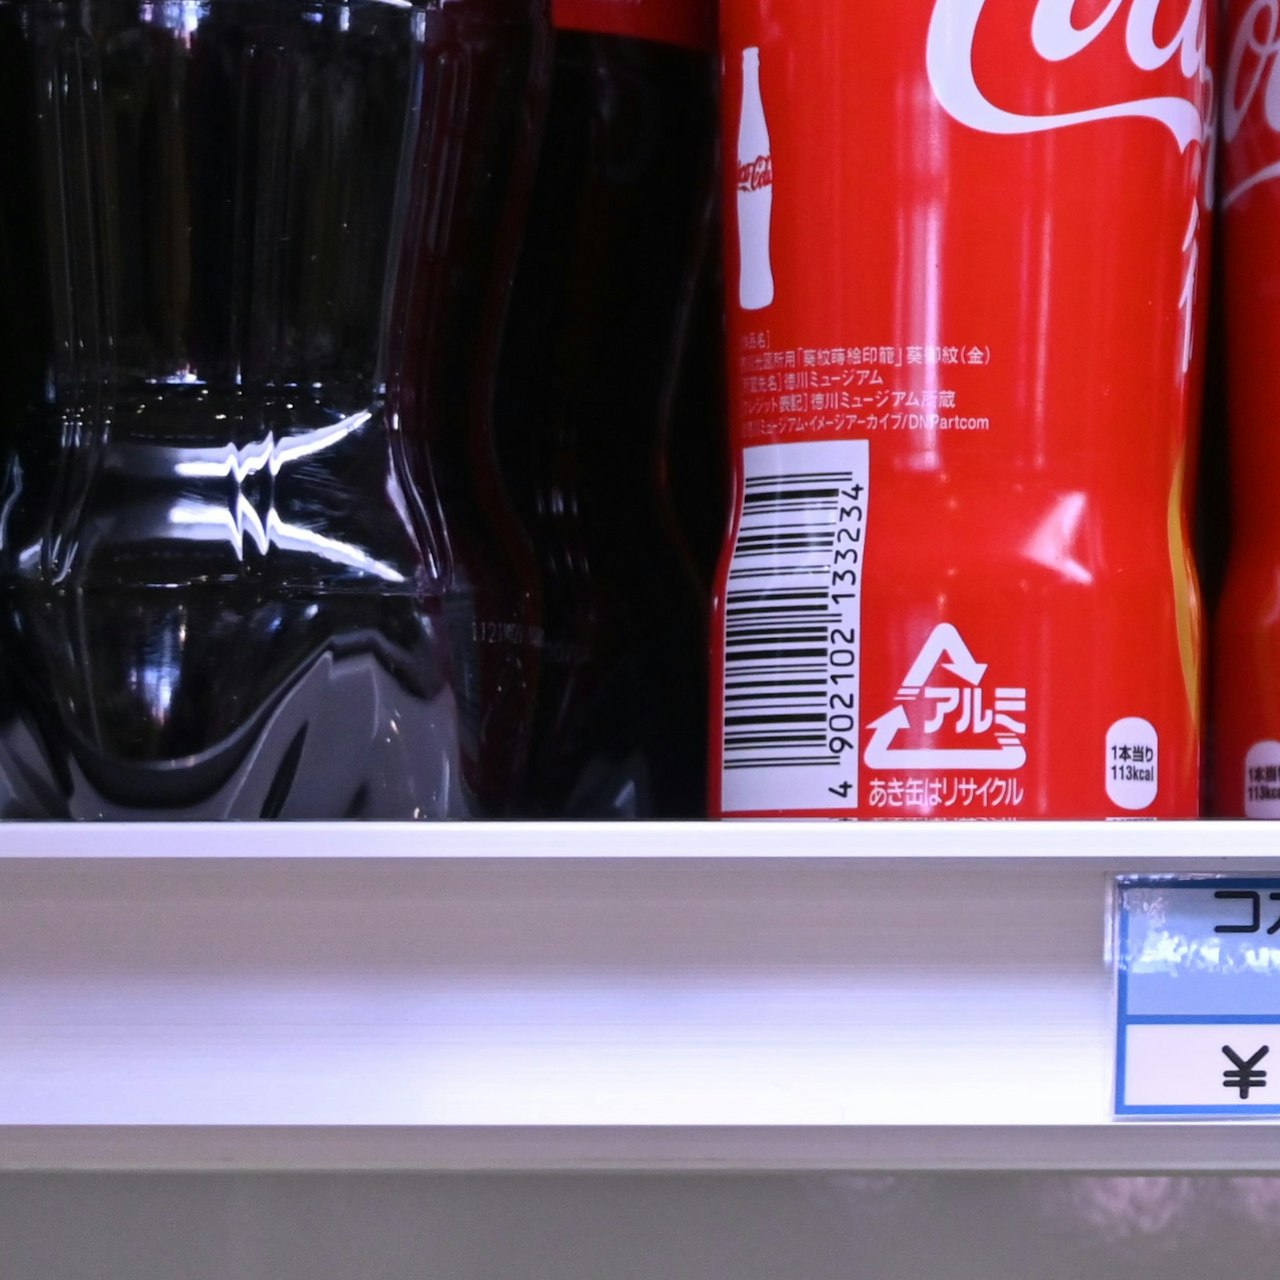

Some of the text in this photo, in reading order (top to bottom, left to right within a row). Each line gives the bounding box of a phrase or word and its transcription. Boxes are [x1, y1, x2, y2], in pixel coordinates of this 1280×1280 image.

[924, 687, 1026, 734] アルミ
[1111, 744, 1154, 763] 1本当り
[1111, 765, 1154, 782] 113kcal
[868, 777, 1024, 808] あき缶はリサイクル
